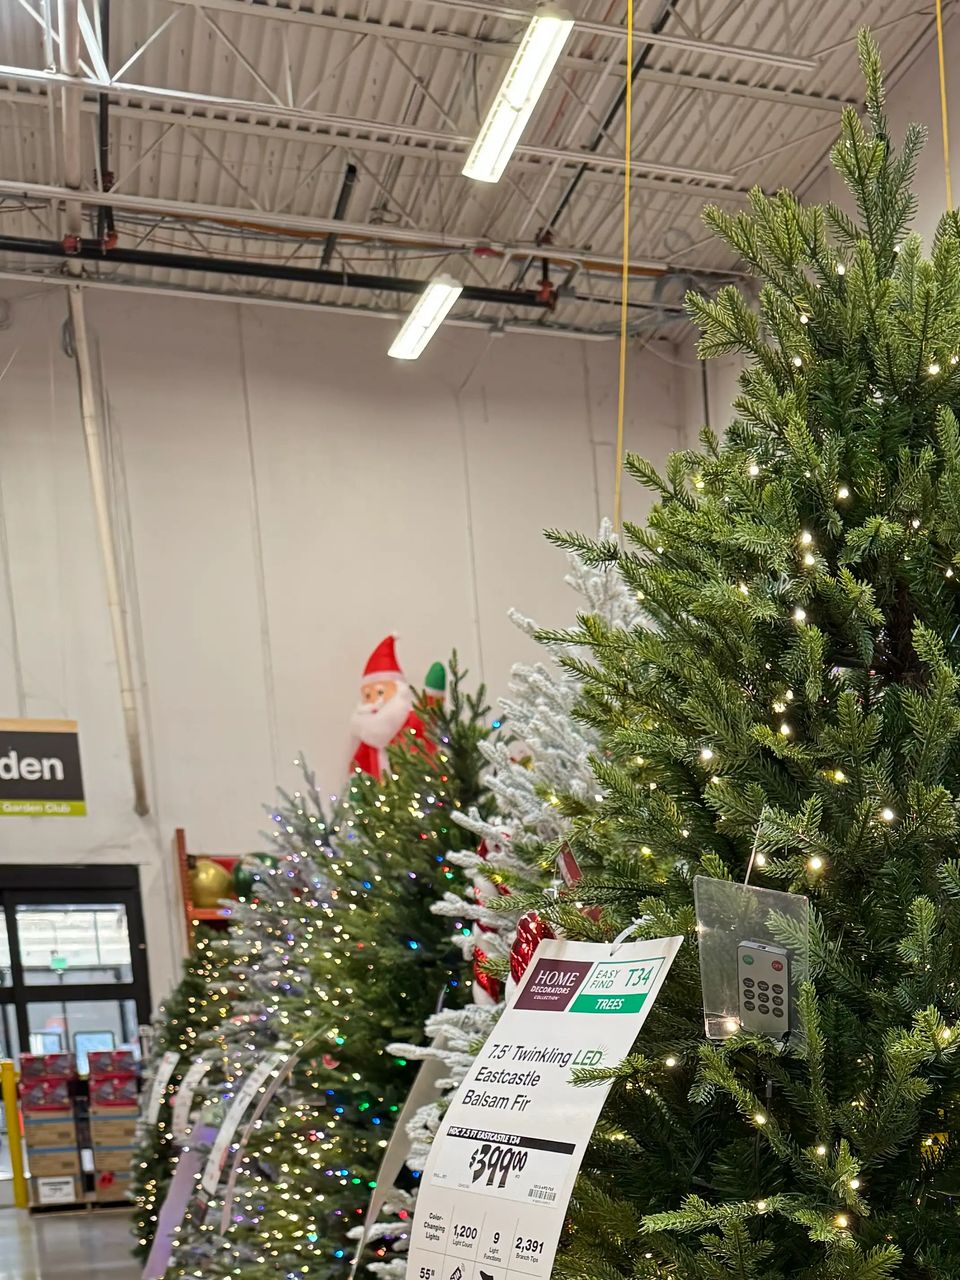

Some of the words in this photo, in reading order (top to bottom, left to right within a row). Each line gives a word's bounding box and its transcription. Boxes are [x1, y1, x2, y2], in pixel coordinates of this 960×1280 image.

[534, 970, 580, 986] HOME
[594, 970, 620, 980] EASY
[624, 966, 654, 988] T34
[530, 985, 570, 994] DECORATORS
[590, 980, 614, 989] FIND
[594, 998, 624, 1010] TREES
[488, 1044, 512, 1060] 7.5'
[512, 1046, 573, 1068] Twinkling
[572, 1050, 603, 1066] LED
[474, 1066, 541, 1087] Eastcastle
[462, 1089, 510, 1110] Balsam
[510, 1094, 532, 1112] Fir
[448, 1126, 460, 1136] HDC
[470, 1130, 478, 1139] FT
[476, 1132, 510, 1143] EASTCASTLE
[509, 1136, 520, 1144] T34
[428, 1212, 444, 1222] Color-
[424, 1222, 446, 1234] Changing
[453, 1224, 478, 1240] 1,200
[425, 1232, 440, 1242] Lights
[493, 1232, 500, 1244] 9
[452, 1239, 462, 1248] Light
[462, 1241, 473, 1249] Count
[515, 1237, 545, 1254] 2,391
[483, 1254, 502, 1263] Functions
[419, 1267, 436, 1280] 55"
